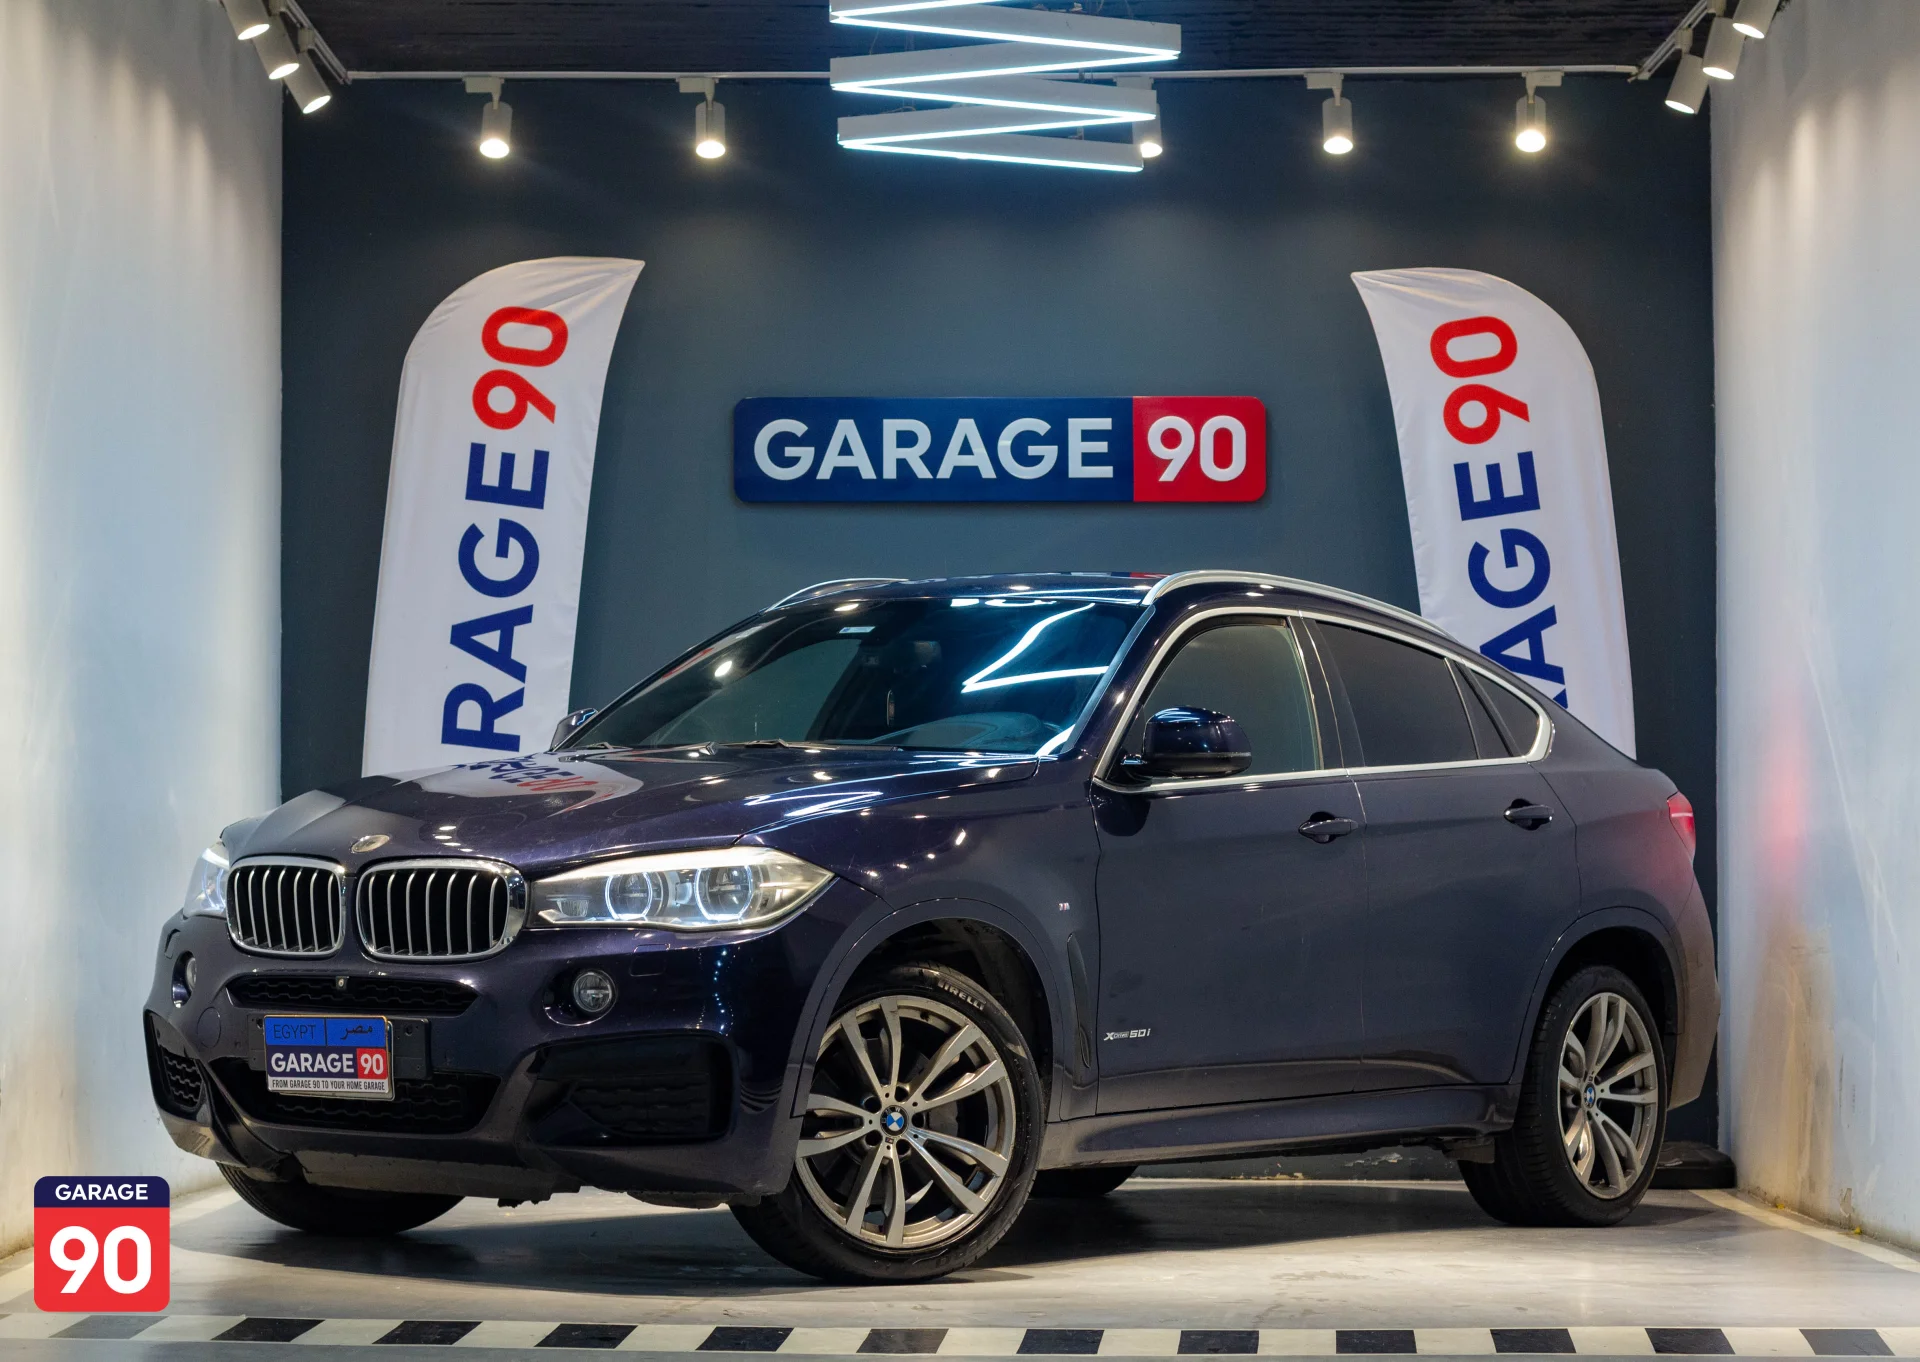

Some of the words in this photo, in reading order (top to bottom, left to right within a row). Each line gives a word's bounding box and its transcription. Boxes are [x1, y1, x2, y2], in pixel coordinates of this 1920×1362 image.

[754, 417, 1114, 480] GARAGE
[1147, 415, 1247, 482] 90
[1453, 450, 1568, 709] AGE
[273, 1023, 317, 1040] EGYPT
[340, 1023, 373, 1040] مصر
[271, 1052, 355, 1073] GARAGE
[360, 1053, 384, 1075] 90
[272, 1080, 288, 1088] FROM
[289, 1080, 312, 1089] GARAGE
[312, 1080, 320, 1089] 90
[321, 1080, 329, 1089] TO
[330, 1081, 345, 1089] YOUR
[346, 1081, 362, 1090] HOME
[363, 1081, 385, 1091] GARAGE
